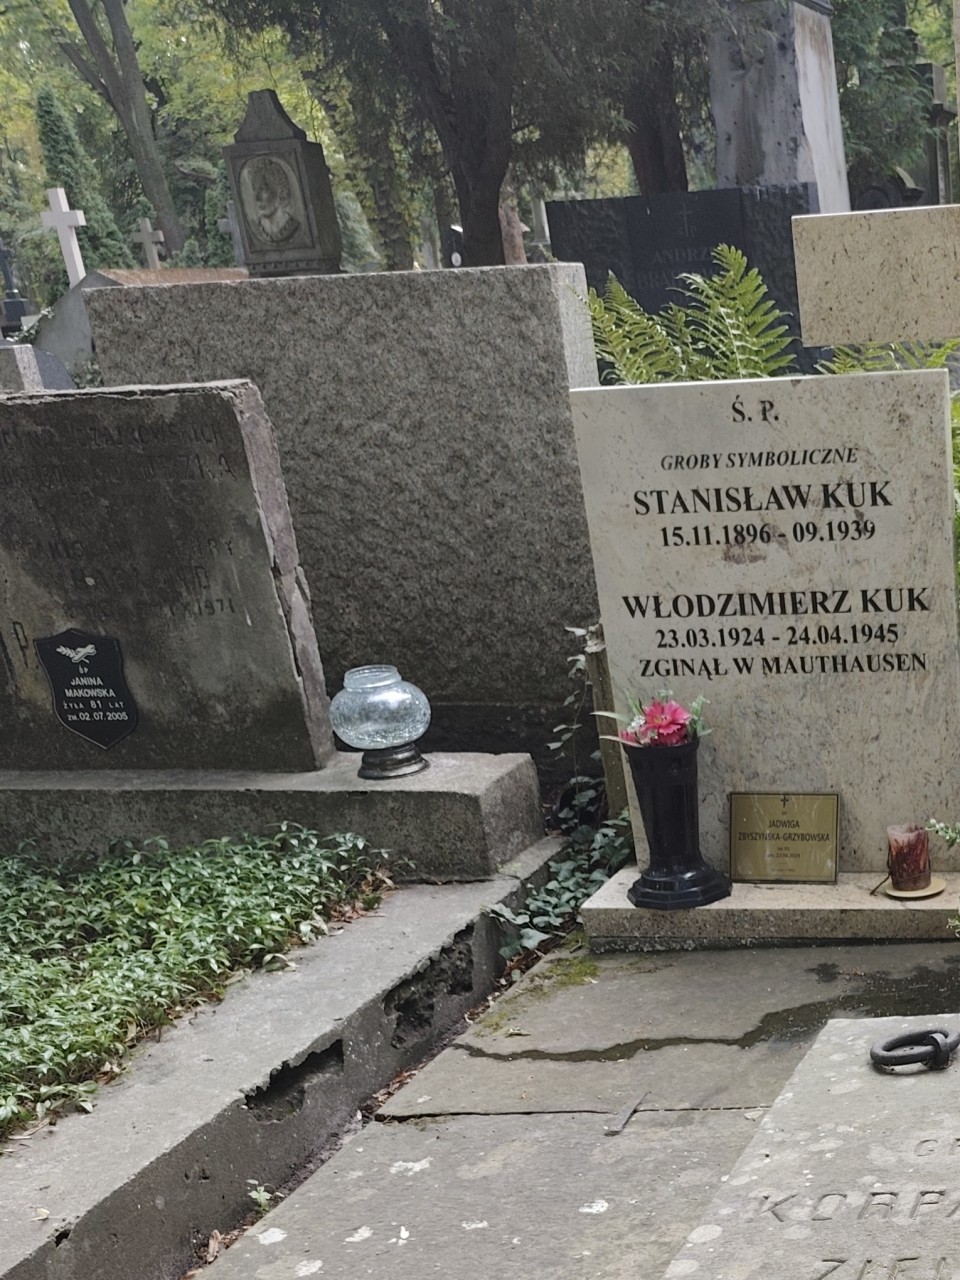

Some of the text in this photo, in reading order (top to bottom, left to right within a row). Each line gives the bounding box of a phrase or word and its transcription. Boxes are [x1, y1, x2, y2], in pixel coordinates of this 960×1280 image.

[660, 447, 859, 471] GROBY SYMBOLICZNE
[633, 480, 893, 515] STANISŁAW KUK
[660, 523, 772, 547] 15.11.1896
[791, 519, 877, 542] 09.1939
[621, 587, 932, 619] WŁODZIMIERZ KUK
[656, 627, 766, 649] 23.03.1924
[787, 623, 899, 645] 24.04.1945
[639, 653, 927, 681] ZGINĄŁ W MAUTHAUSEN
[64, 688, 117, 698] MAKOWSKA
[71, 677, 104, 686] JANINA
[768, 819, 800, 828] JADWIGA
